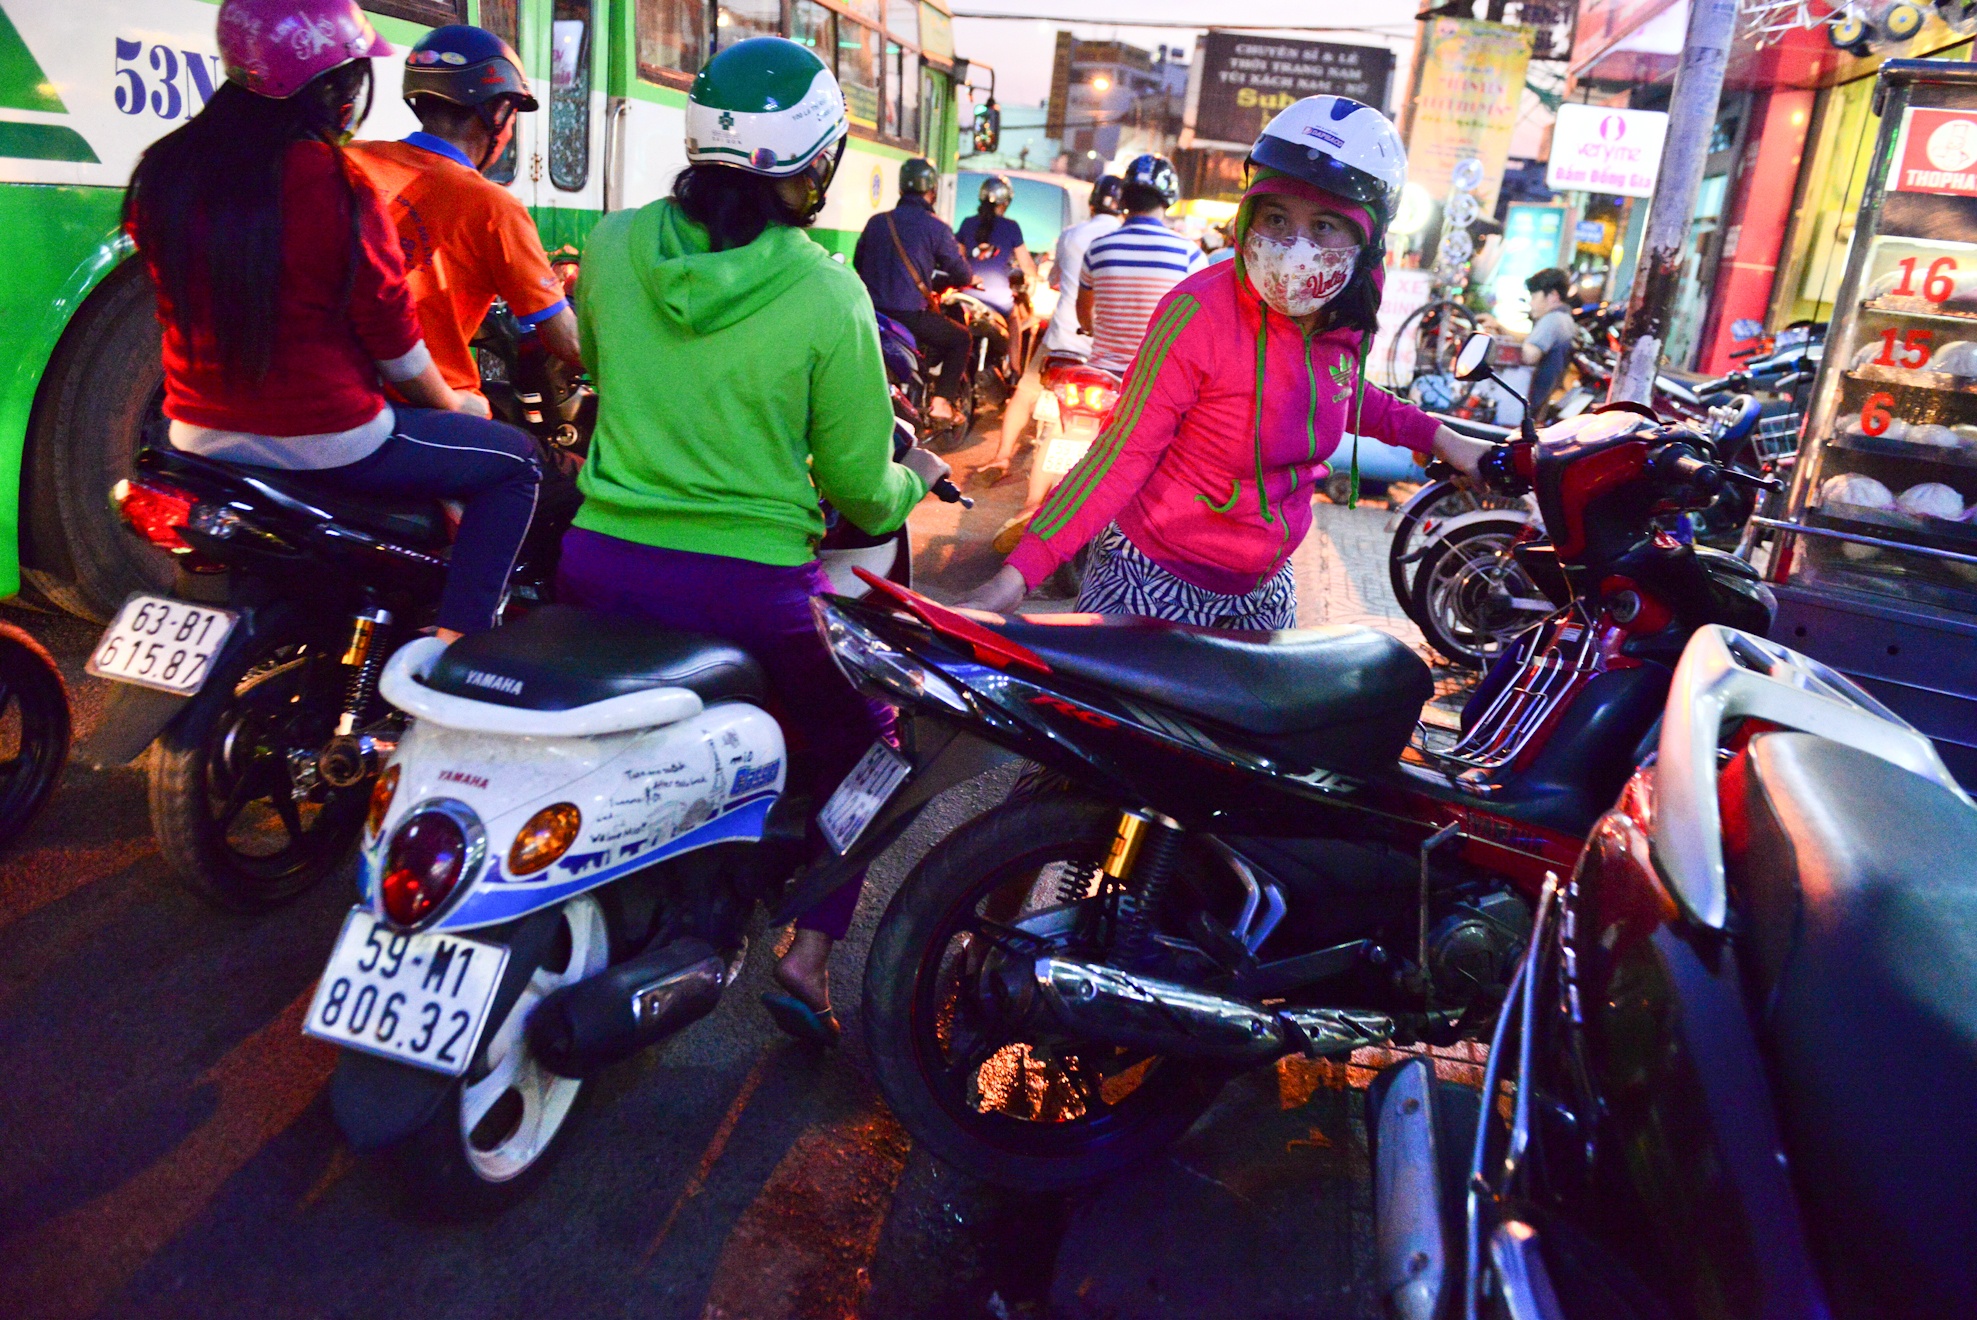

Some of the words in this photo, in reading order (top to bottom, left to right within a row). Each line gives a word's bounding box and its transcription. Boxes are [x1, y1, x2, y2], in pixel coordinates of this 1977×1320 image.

[114, 37, 220, 120] 53N
[1236, 87, 1297, 110] Sub
[1906, 169, 1977, 190] THOPHA
[1892, 256, 1958, 303] 16
[1874, 327, 1934, 369] 15
[1860, 391, 1895, 437] 6
[132, 602, 215, 646] 63-B1
[100, 636, 208, 684] 615.87
[465, 670, 523, 695] YAMAHA
[439, 770, 489, 789] YAMAHA
[358, 922, 475, 998] 59-M1
[322, 977, 470, 1062] 806.32
